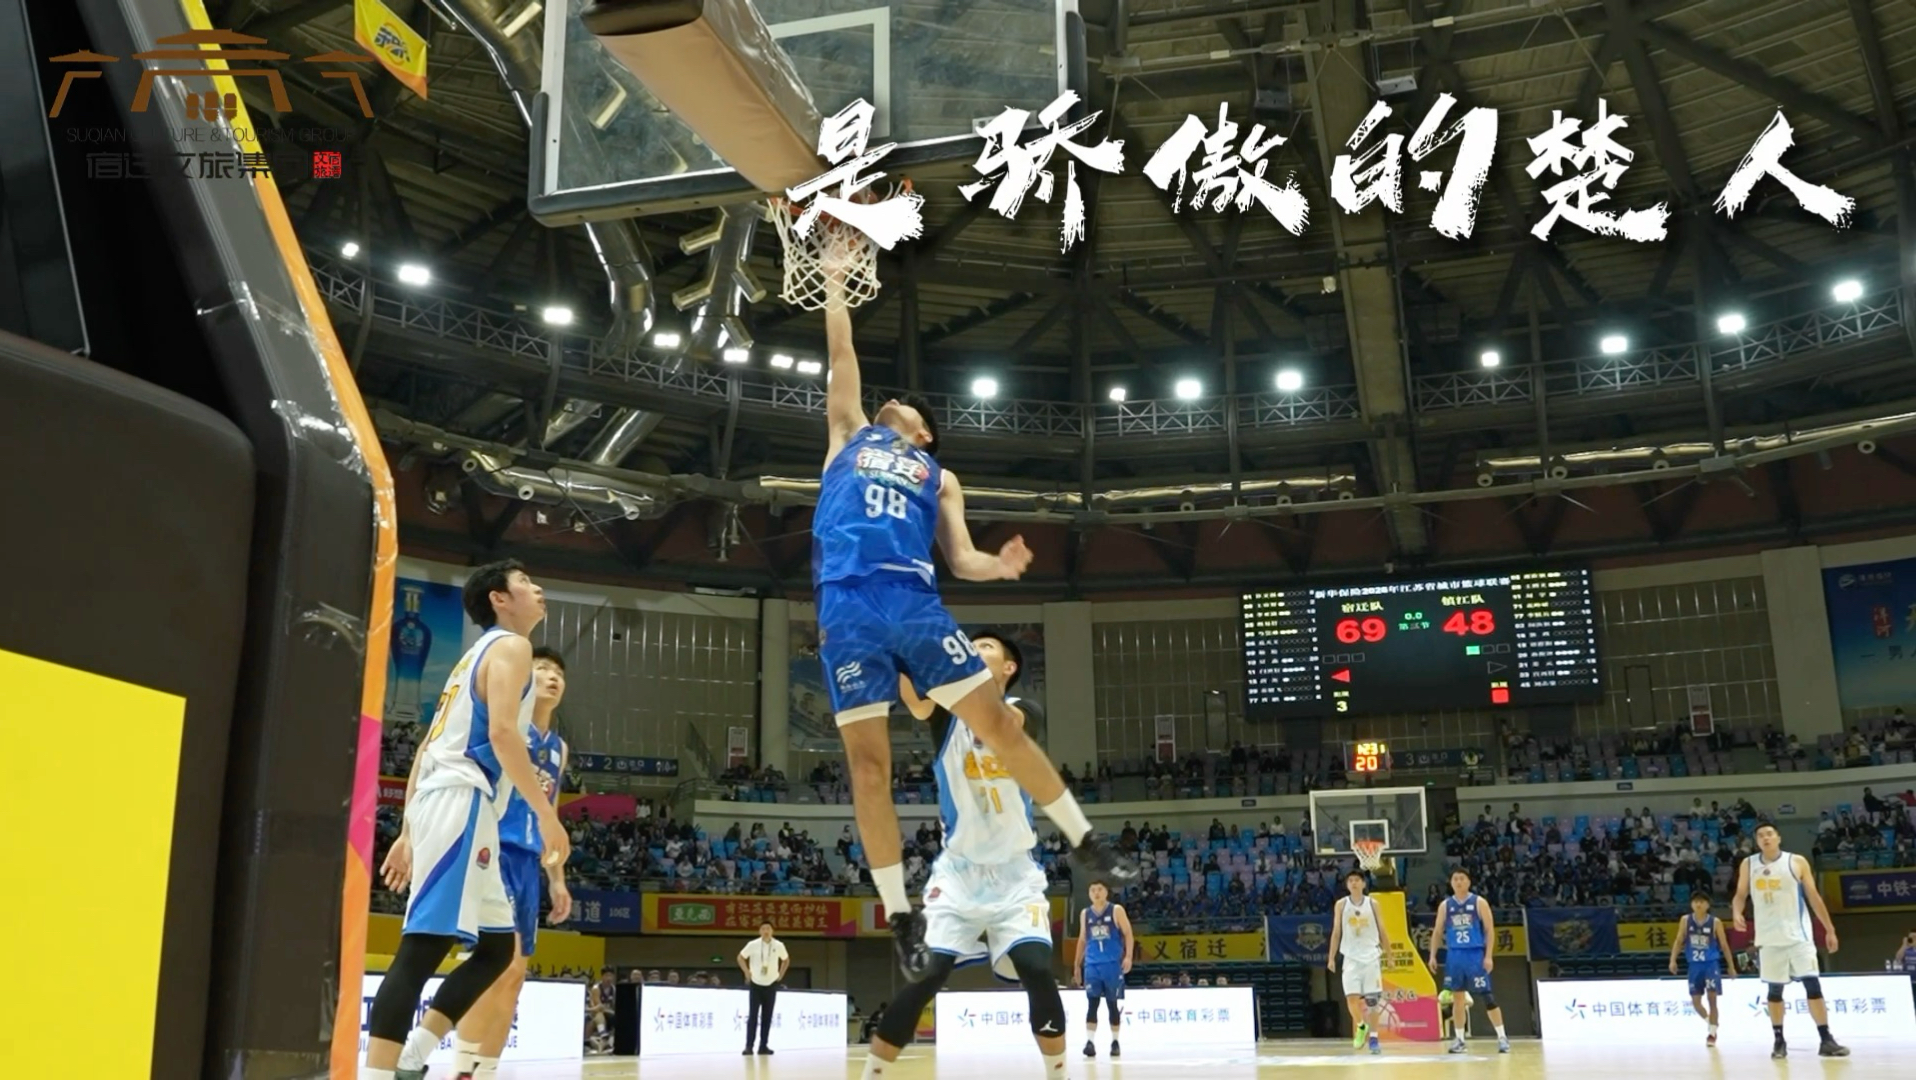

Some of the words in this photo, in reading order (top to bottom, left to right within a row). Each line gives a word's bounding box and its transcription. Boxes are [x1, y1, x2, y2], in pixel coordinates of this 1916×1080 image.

[864, 485, 907, 519] 98
[1341, 601, 1384, 613] 宿迁队
[1336, 617, 1387, 644] 69
[1442, 610, 1495, 636] 48
[1336, 701, 1348, 712] 3
[1355, 755, 1378, 771] 20
[1456, 931, 1470, 944] 25
[1692, 951, 1706, 962] 24
[1474, 976, 1487, 988] 25
[1593, 1000, 1697, 1017] 中国体育彩票
[1784, 997, 1887, 1014] 国育彩票
[1138, 1008, 1230, 1024] 中国体育彩票
